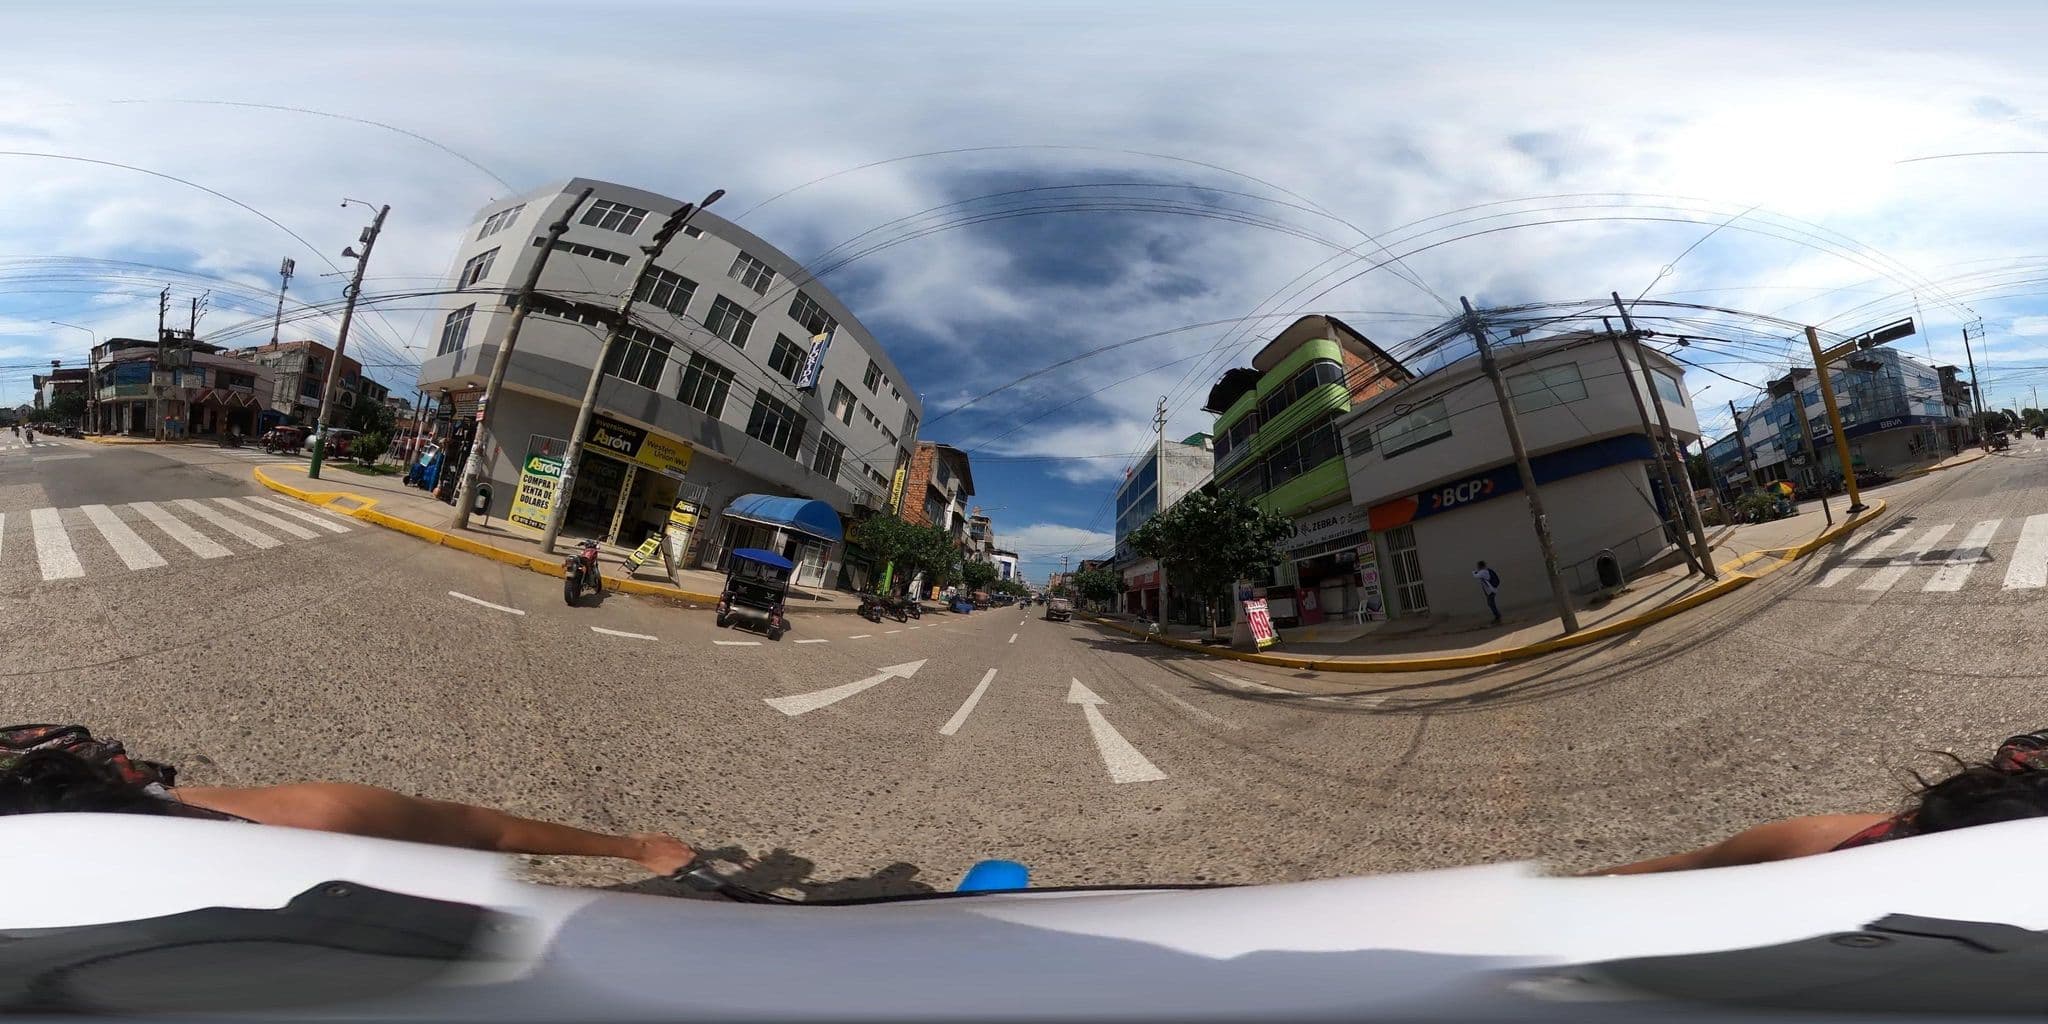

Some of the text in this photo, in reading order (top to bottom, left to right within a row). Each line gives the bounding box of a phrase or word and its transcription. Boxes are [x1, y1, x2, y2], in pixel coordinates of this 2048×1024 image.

[1881, 418, 1902, 429] BBVA
[593, 428, 632, 452] Aarón
[528, 457, 560, 476] Aarón
[523, 475, 551, 490] COMPRA
[522, 485, 552, 500] VENTA DE
[1443, 481, 1482, 507] BCP
[520, 495, 549, 509] DOLARES
[1312, 517, 1338, 532] ZEBRA
